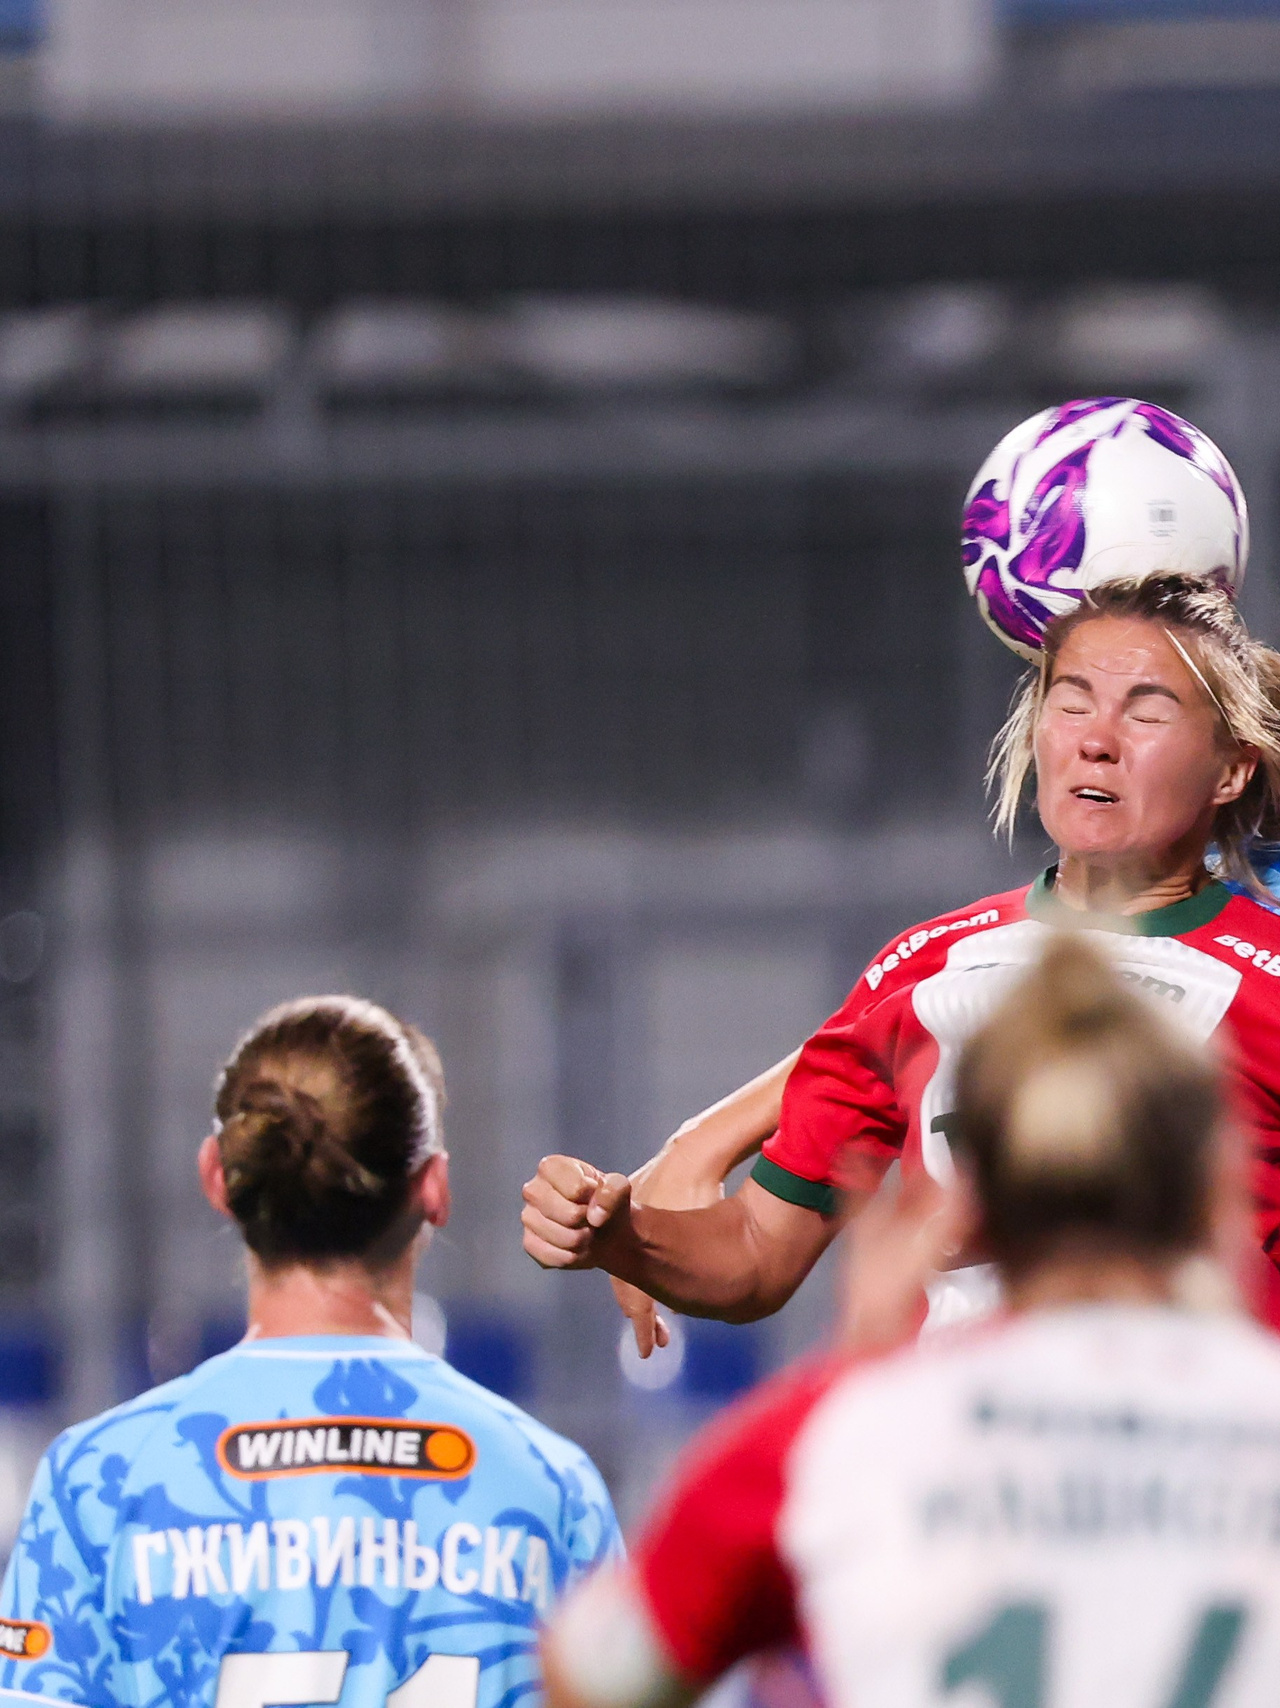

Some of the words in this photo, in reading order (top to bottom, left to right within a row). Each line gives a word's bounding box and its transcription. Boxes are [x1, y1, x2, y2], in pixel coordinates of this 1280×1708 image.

[864, 908, 1000, 991] BetBoom
[237, 1427, 421, 1469] WINLINE
[132, 1515, 550, 1607] ГЖИВИНЬСКА
